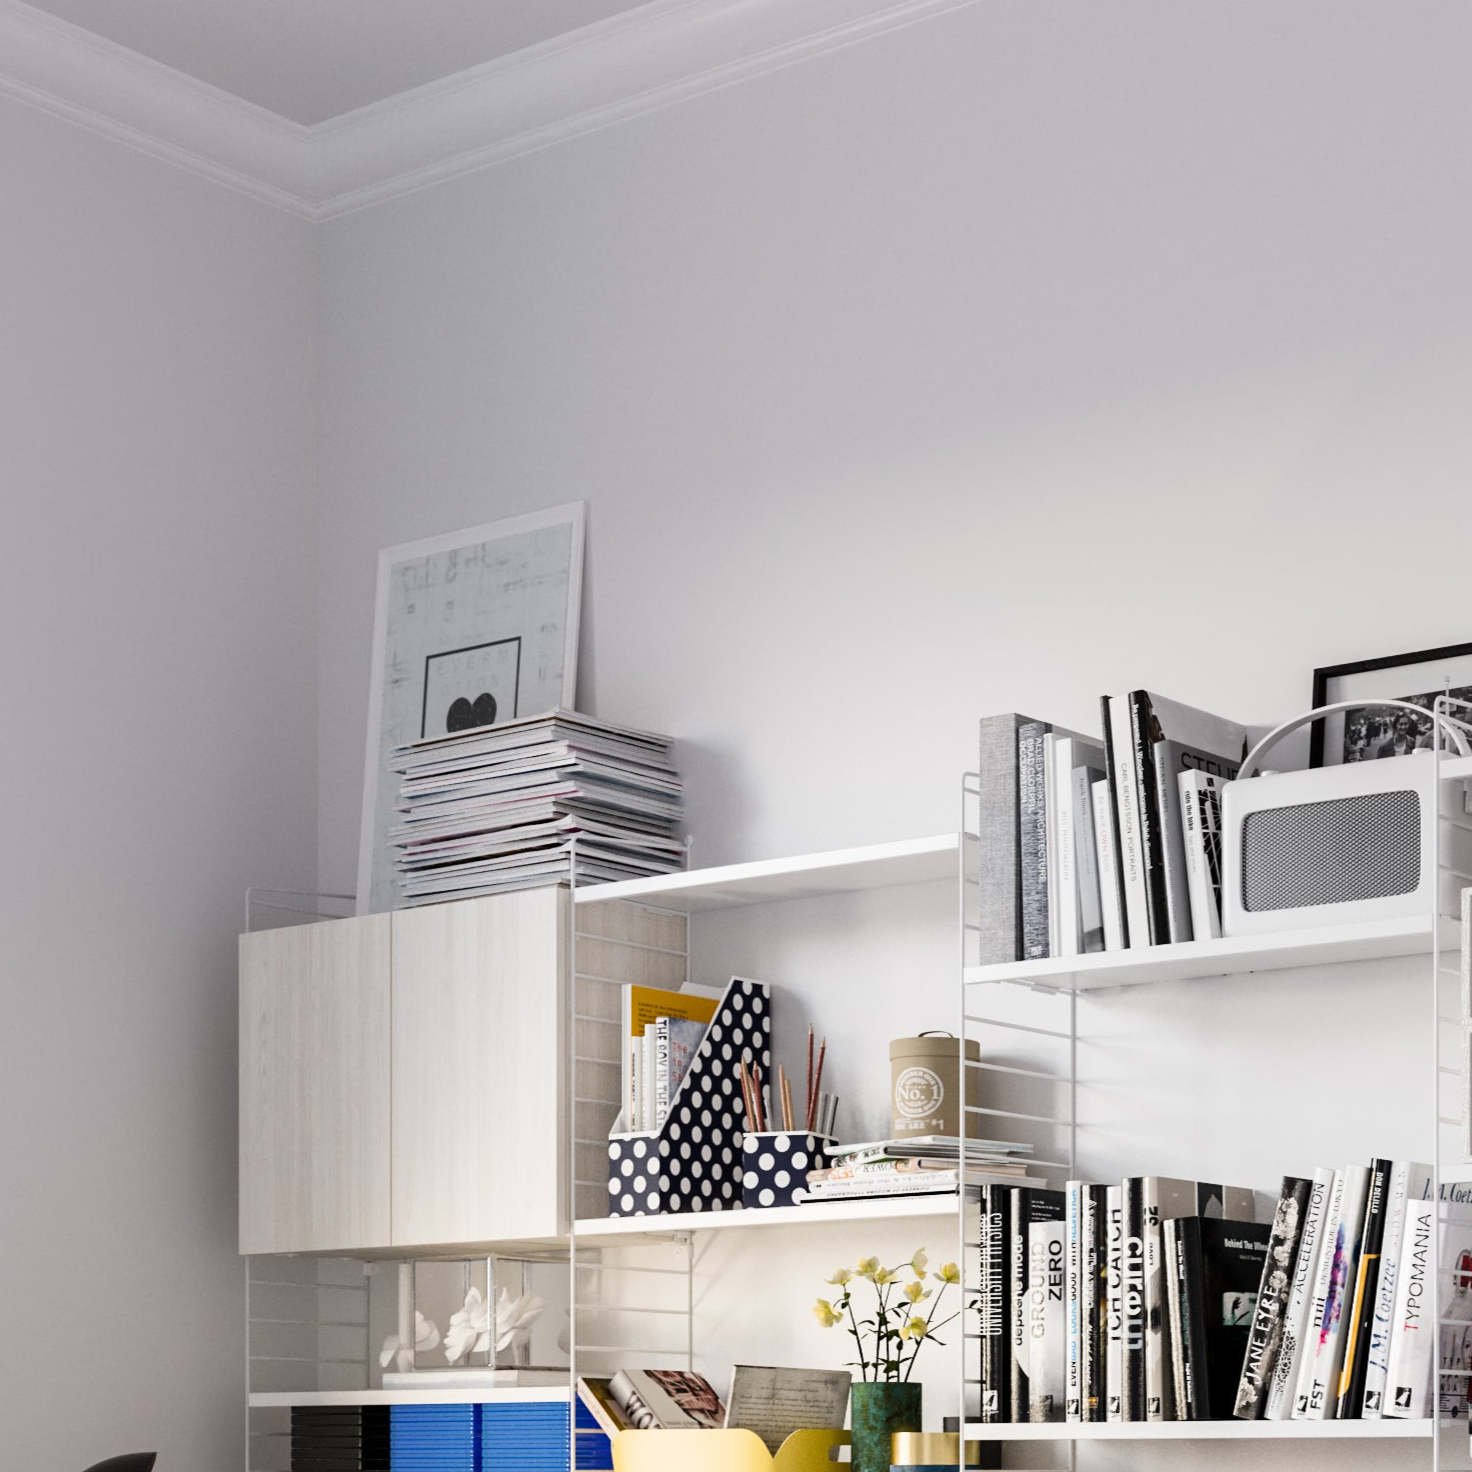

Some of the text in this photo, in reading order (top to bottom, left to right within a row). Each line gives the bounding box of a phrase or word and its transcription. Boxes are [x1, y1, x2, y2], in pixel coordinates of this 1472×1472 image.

[1122, 785, 1133, 834] BENGTSSON
[1127, 837, 1137, 882] PORTRAITS
[898, 1085, 939, 1100] No. 1
[1293, 1182, 1325, 1293] ACCELERATION
[1403, 1213, 1432, 1332] TYPOMANIA
[1014, 1235, 1025, 1346] depeche mode
[1031, 1240, 1062, 1339] GROUND ZERO
[1246, 1284, 1279, 1384] JANE EYRE
